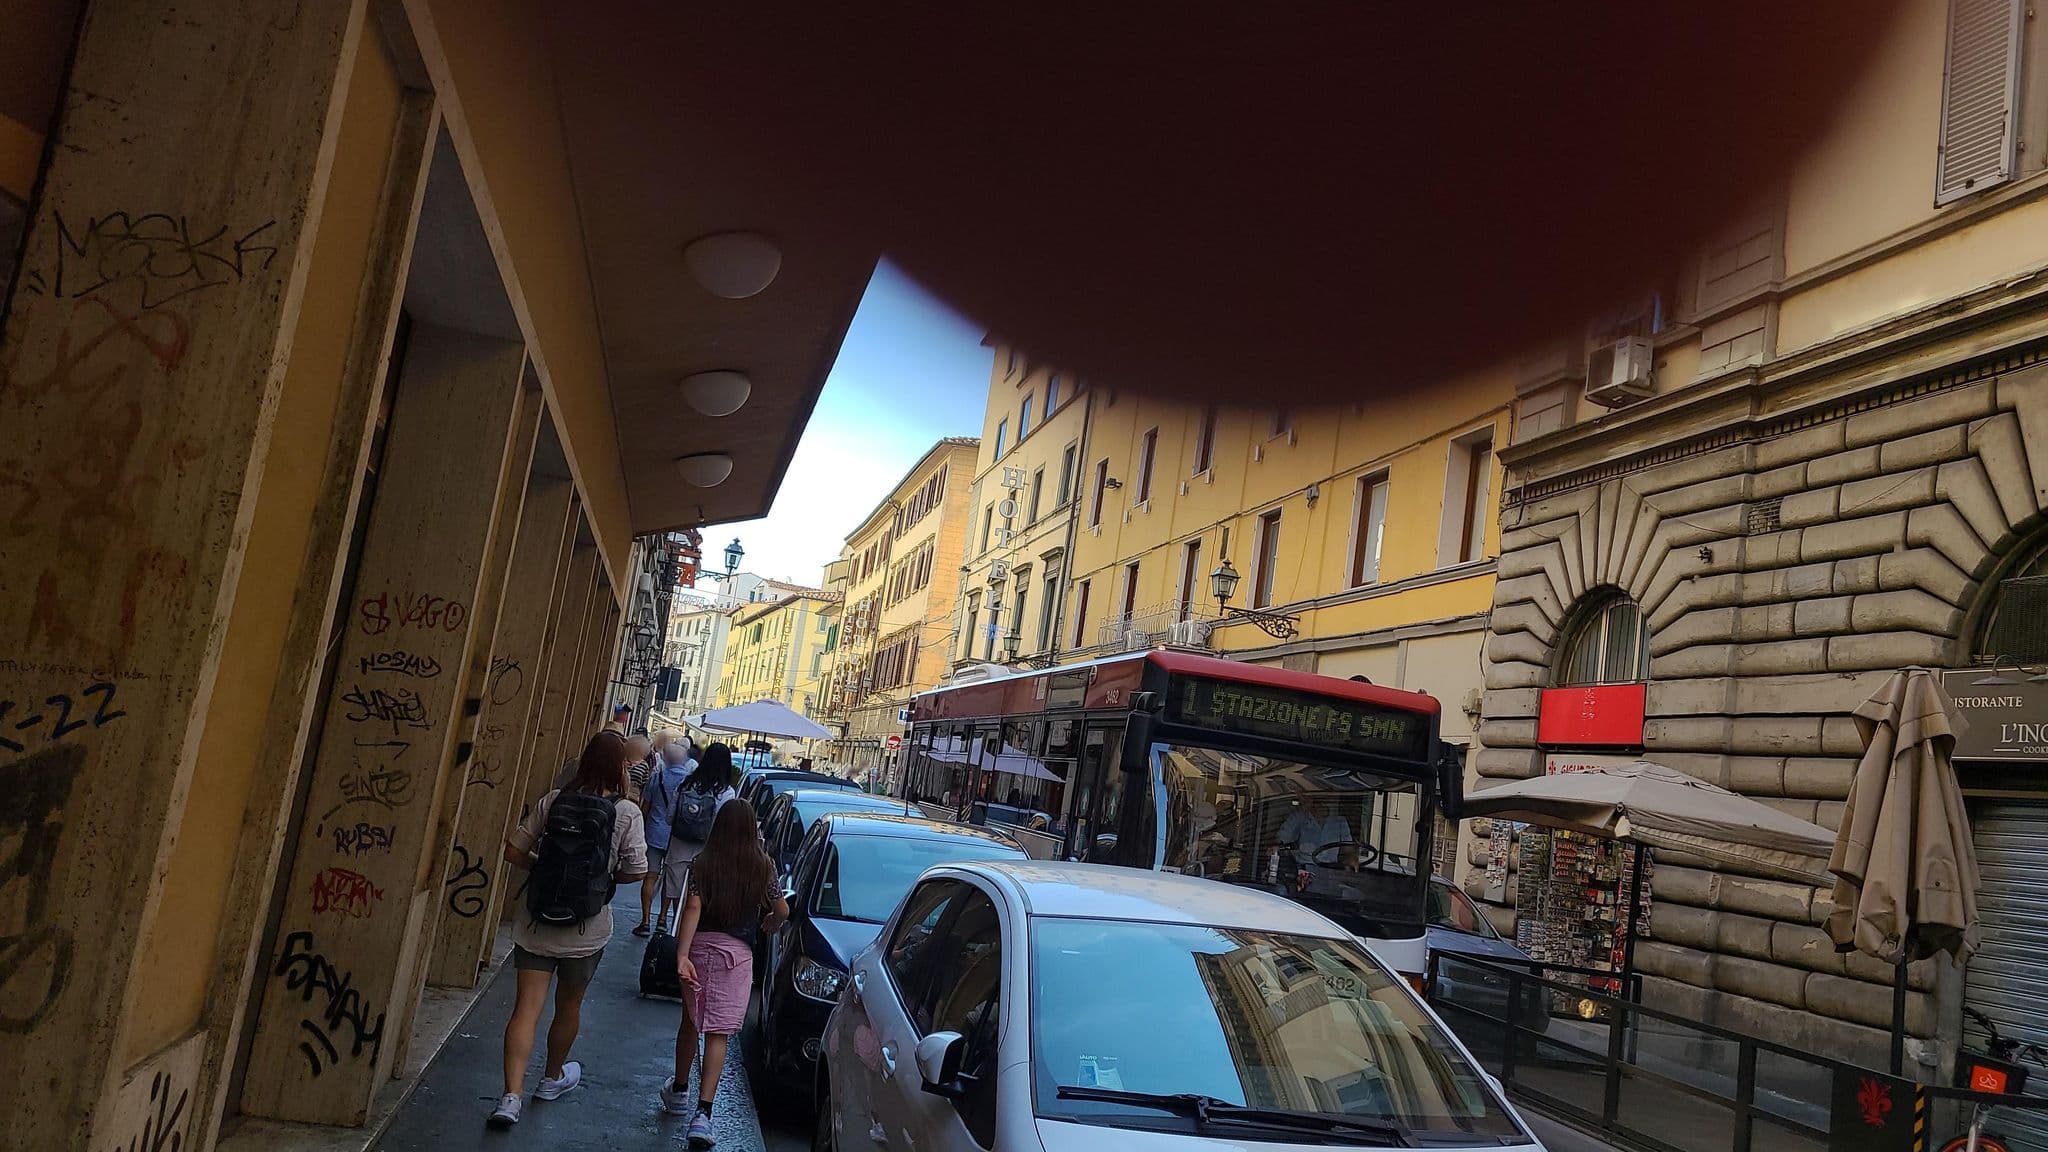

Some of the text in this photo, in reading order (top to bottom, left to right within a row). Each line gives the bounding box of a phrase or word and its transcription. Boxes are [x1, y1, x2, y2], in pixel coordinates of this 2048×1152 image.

[984, 467, 1026, 611] HOTEL
[655, 590, 705, 607] TRAORIA
[1954, 696, 2024, 708] ISTORANTE
[1210, 689, 1322, 728] STAZIONE
[1325, 710, 1353, 734] FS
[1358, 714, 1407, 742] SMN
[2023, 746, 2048, 754] COOK
